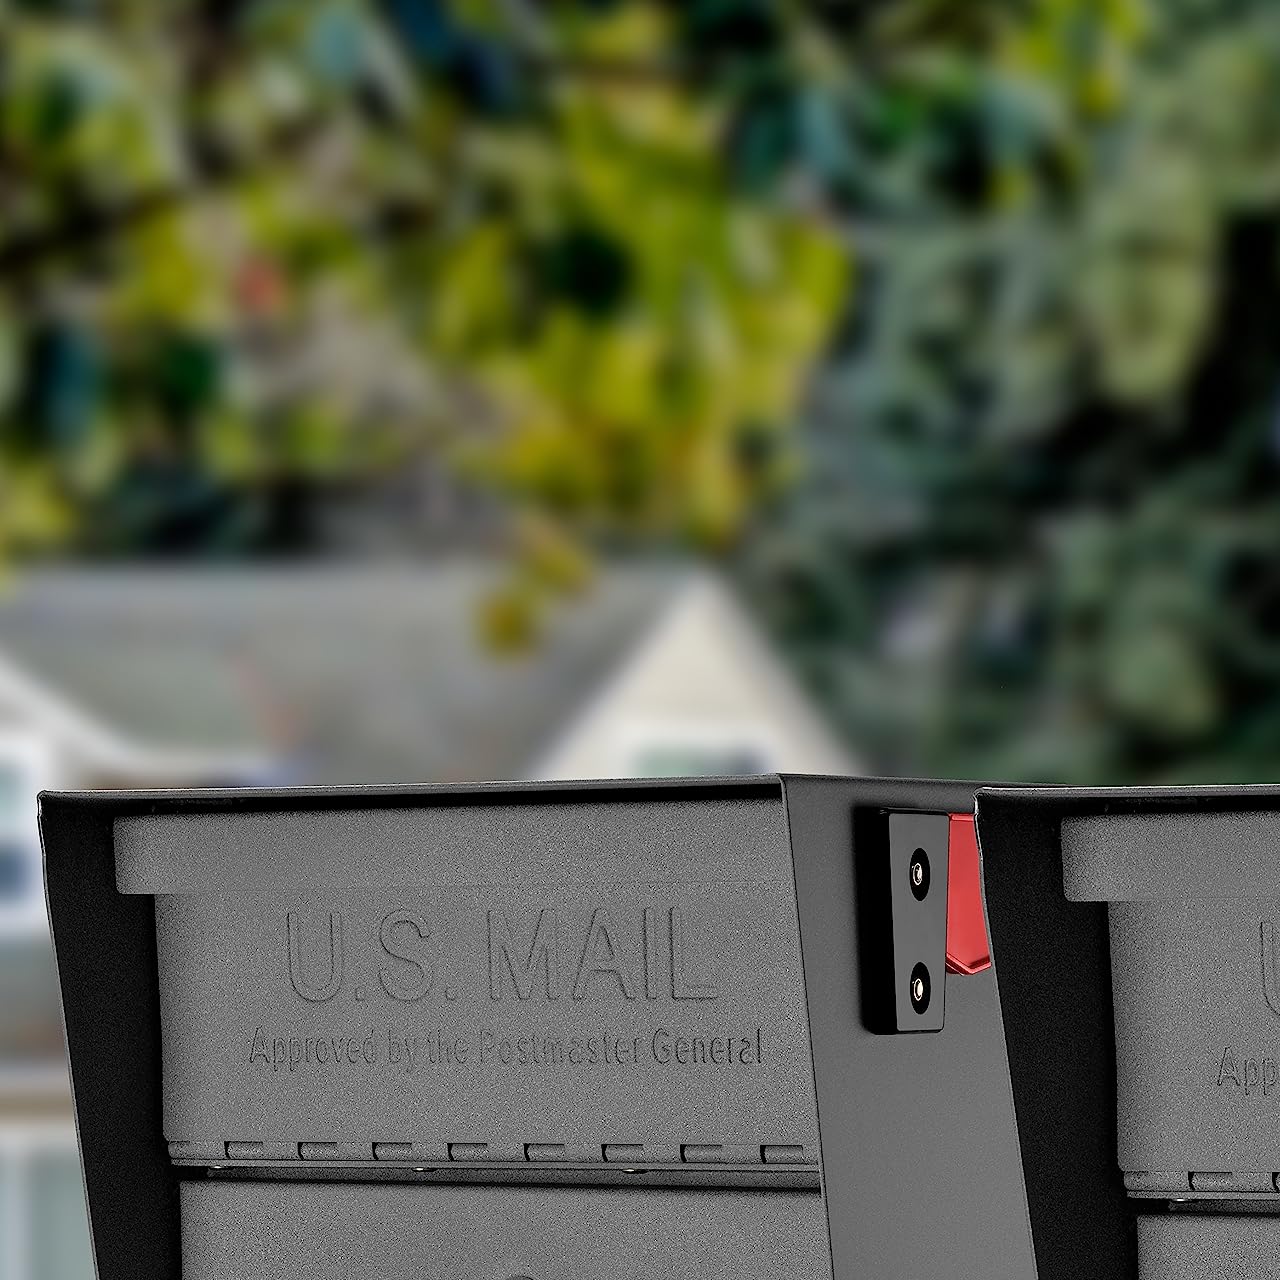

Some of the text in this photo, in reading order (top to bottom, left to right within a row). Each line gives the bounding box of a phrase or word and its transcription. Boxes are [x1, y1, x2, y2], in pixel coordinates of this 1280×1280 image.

[286, 906, 718, 1002] U.S. MAIL
[250, 1026, 763, 1073] Approved by the Postmaster General
